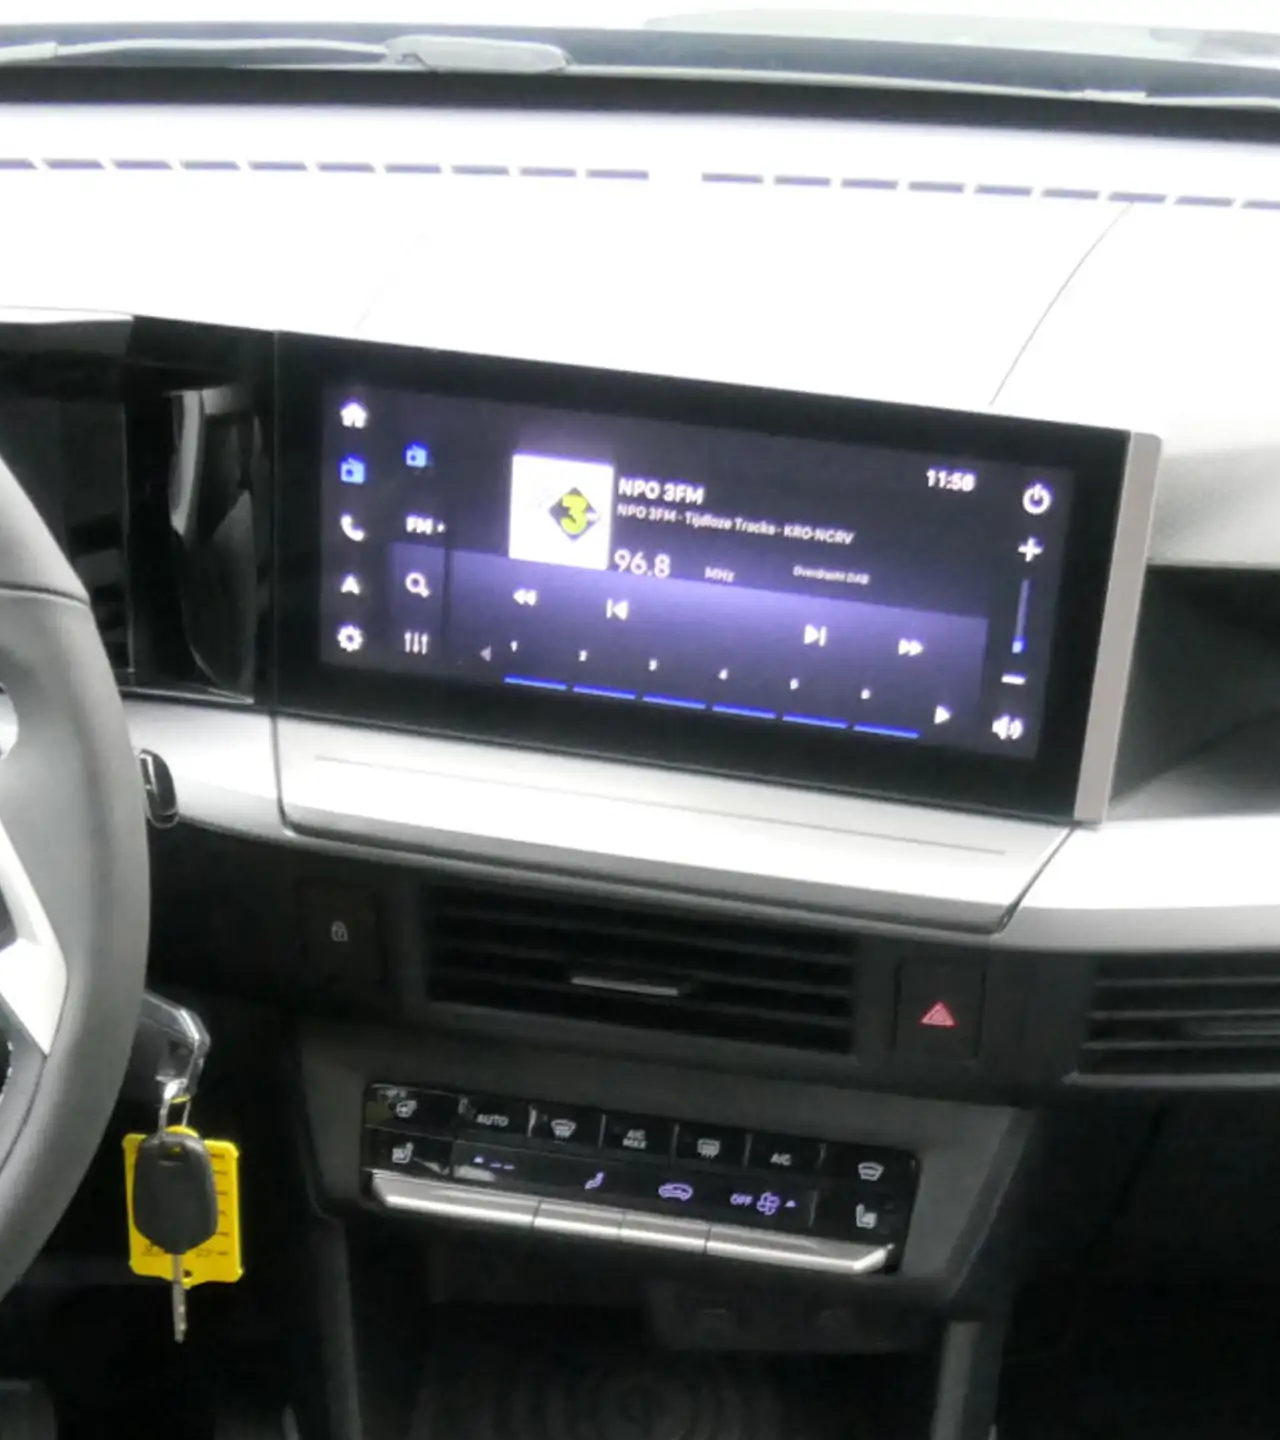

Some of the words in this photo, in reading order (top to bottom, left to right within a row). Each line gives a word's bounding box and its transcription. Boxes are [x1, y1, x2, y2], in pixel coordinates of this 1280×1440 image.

[618, 477, 660, 500] NPO
[663, 483, 705, 505] 3FM
[406, 515, 433, 535] FM
[617, 503, 646, 519] NPO
[648, 507, 676, 523] 3FM
[734, 517, 776, 536] Tracks
[784, 522, 855, 545] KRO-NCRV
[614, 549, 671, 579] 96.8
[704, 566, 736, 583] MHz
[475, 1114, 510, 1128] AUTO
[770, 1153, 792, 1167] A/C
[730, 1193, 754, 1207] OFF
